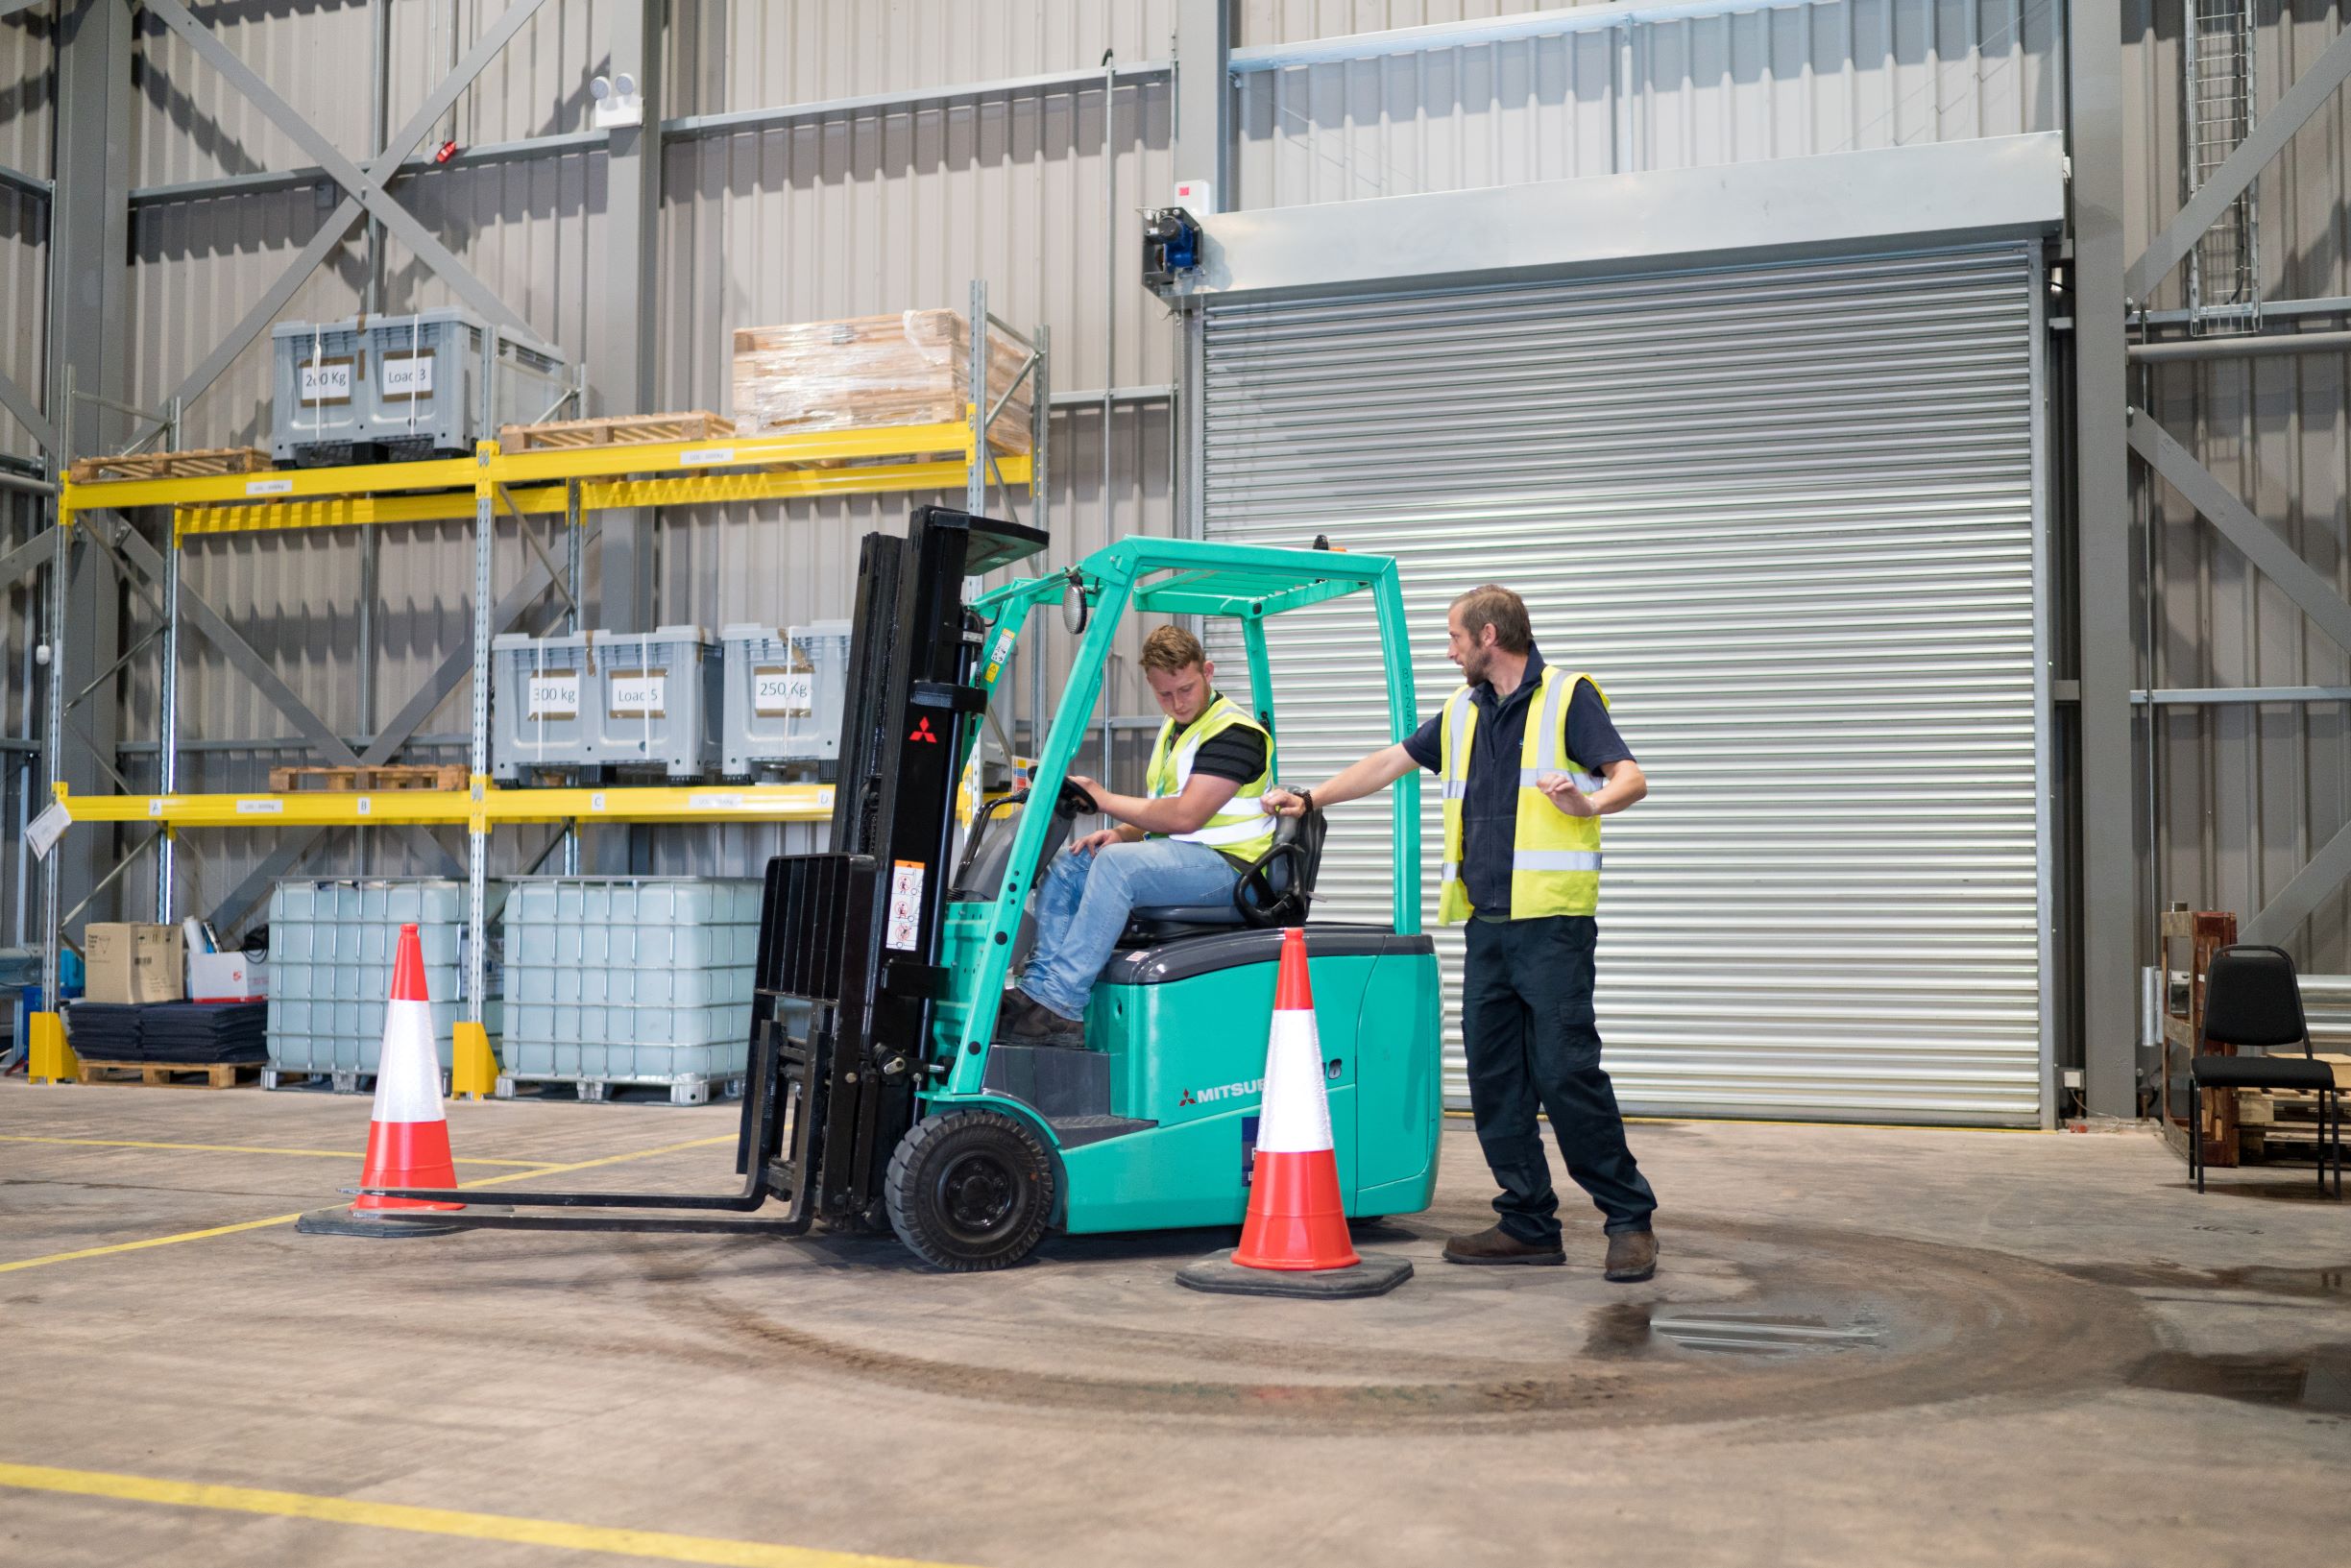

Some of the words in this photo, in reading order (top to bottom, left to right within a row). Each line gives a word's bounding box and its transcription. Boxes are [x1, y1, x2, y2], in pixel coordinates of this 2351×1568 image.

[306, 373, 328, 387] 20
[331, 371, 346, 386] Kg
[420, 368, 426, 380] 3
[561, 687, 575, 703] kg
[650, 688, 658, 701] 5
[760, 682, 787, 696] 250
[790, 681, 808, 698] Kg
